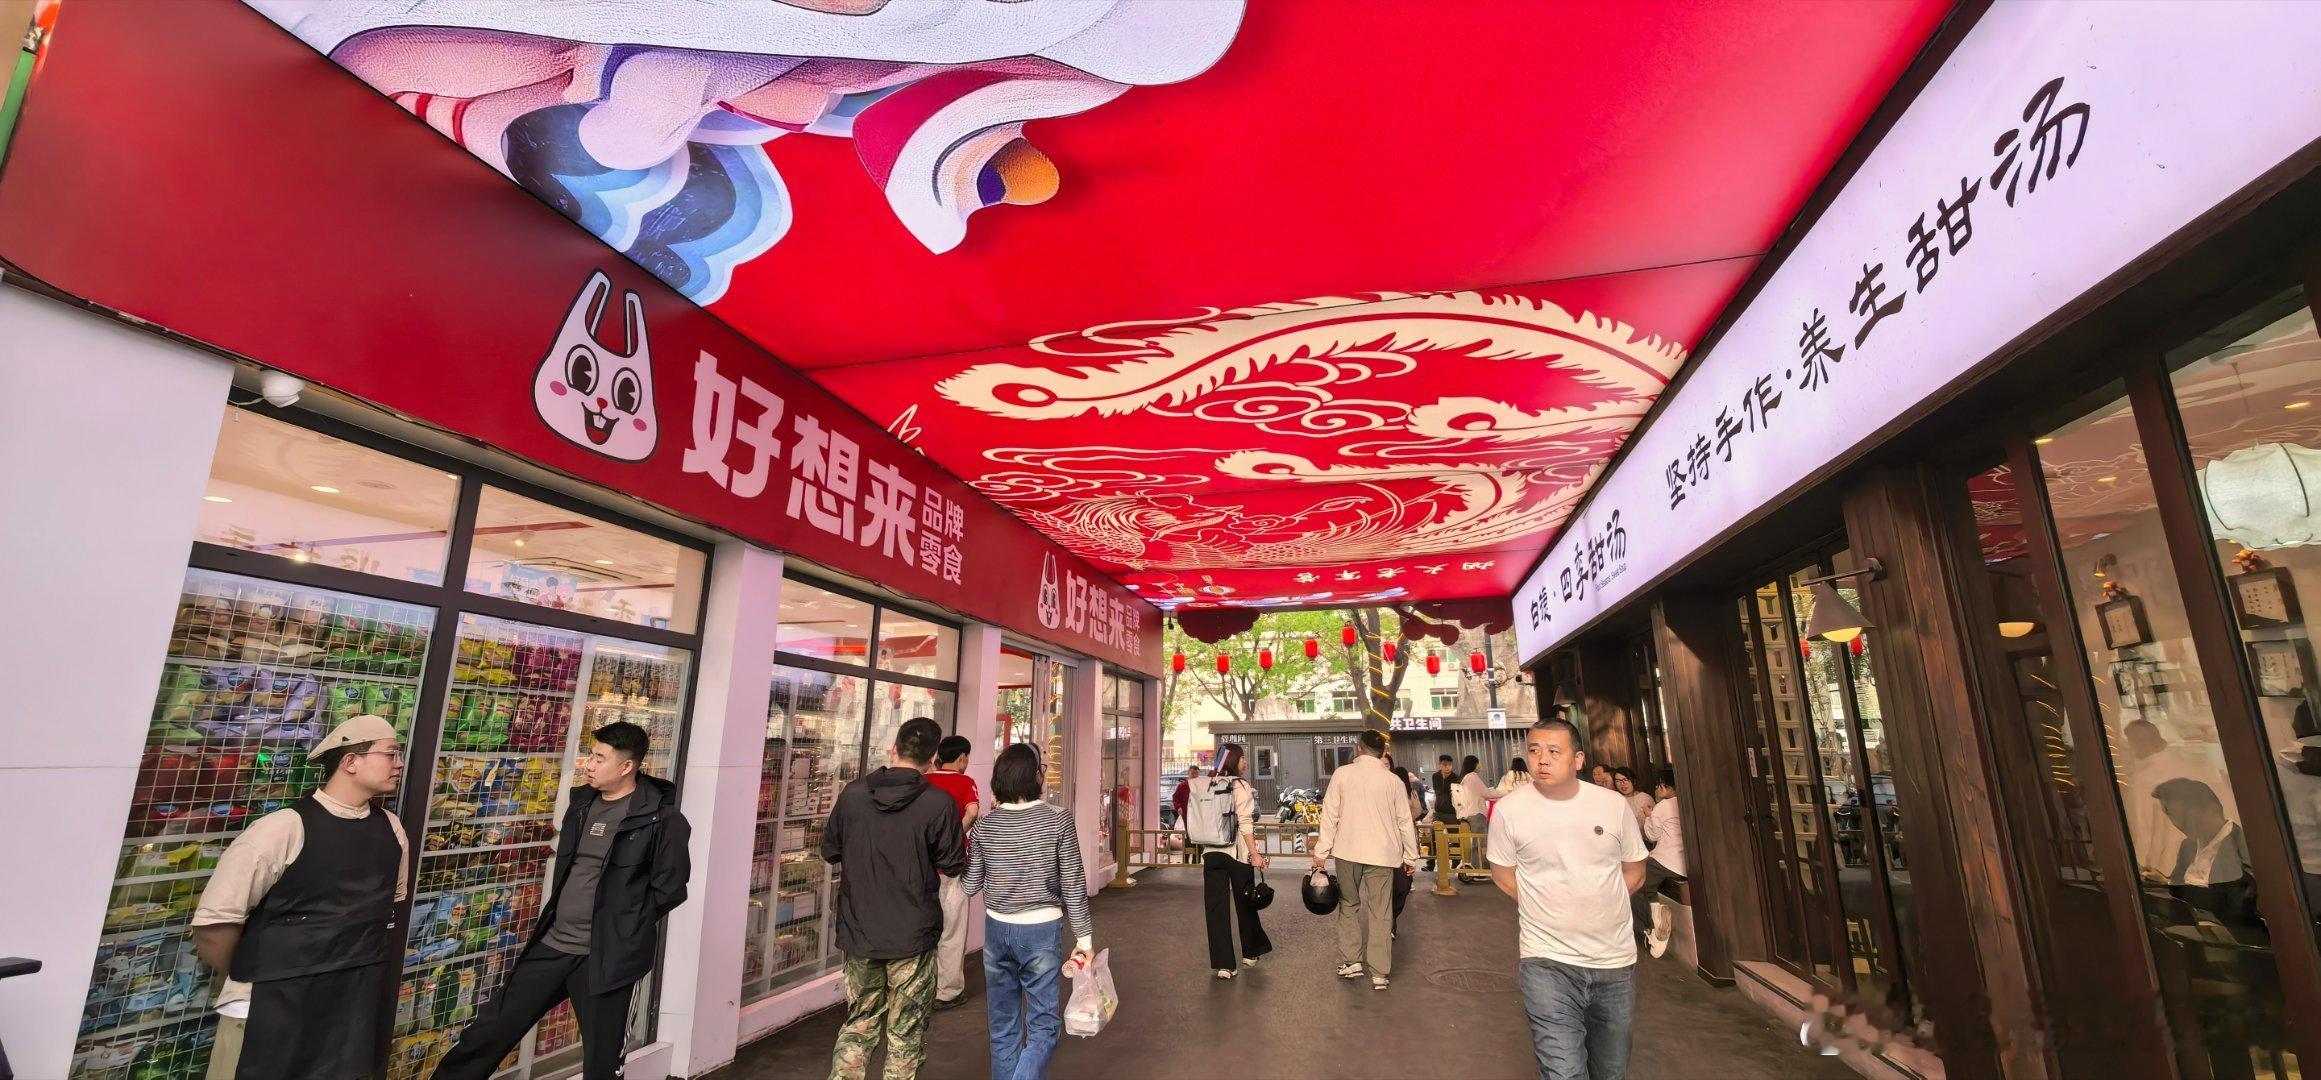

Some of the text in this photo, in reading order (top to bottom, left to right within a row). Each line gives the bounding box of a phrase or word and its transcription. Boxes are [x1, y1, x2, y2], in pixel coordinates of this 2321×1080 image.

[1666, 77, 2090, 511] 坚持手作·养生甜汤
[682, 349, 917, 567] 好想来
[922, 486, 964, 542] 品牌
[920, 529, 963, 586] 零食
[1065, 569, 1126, 652] 好想来
[1125, 604, 1140, 632] 品牌
[1125, 629, 1140, 657] 零食
